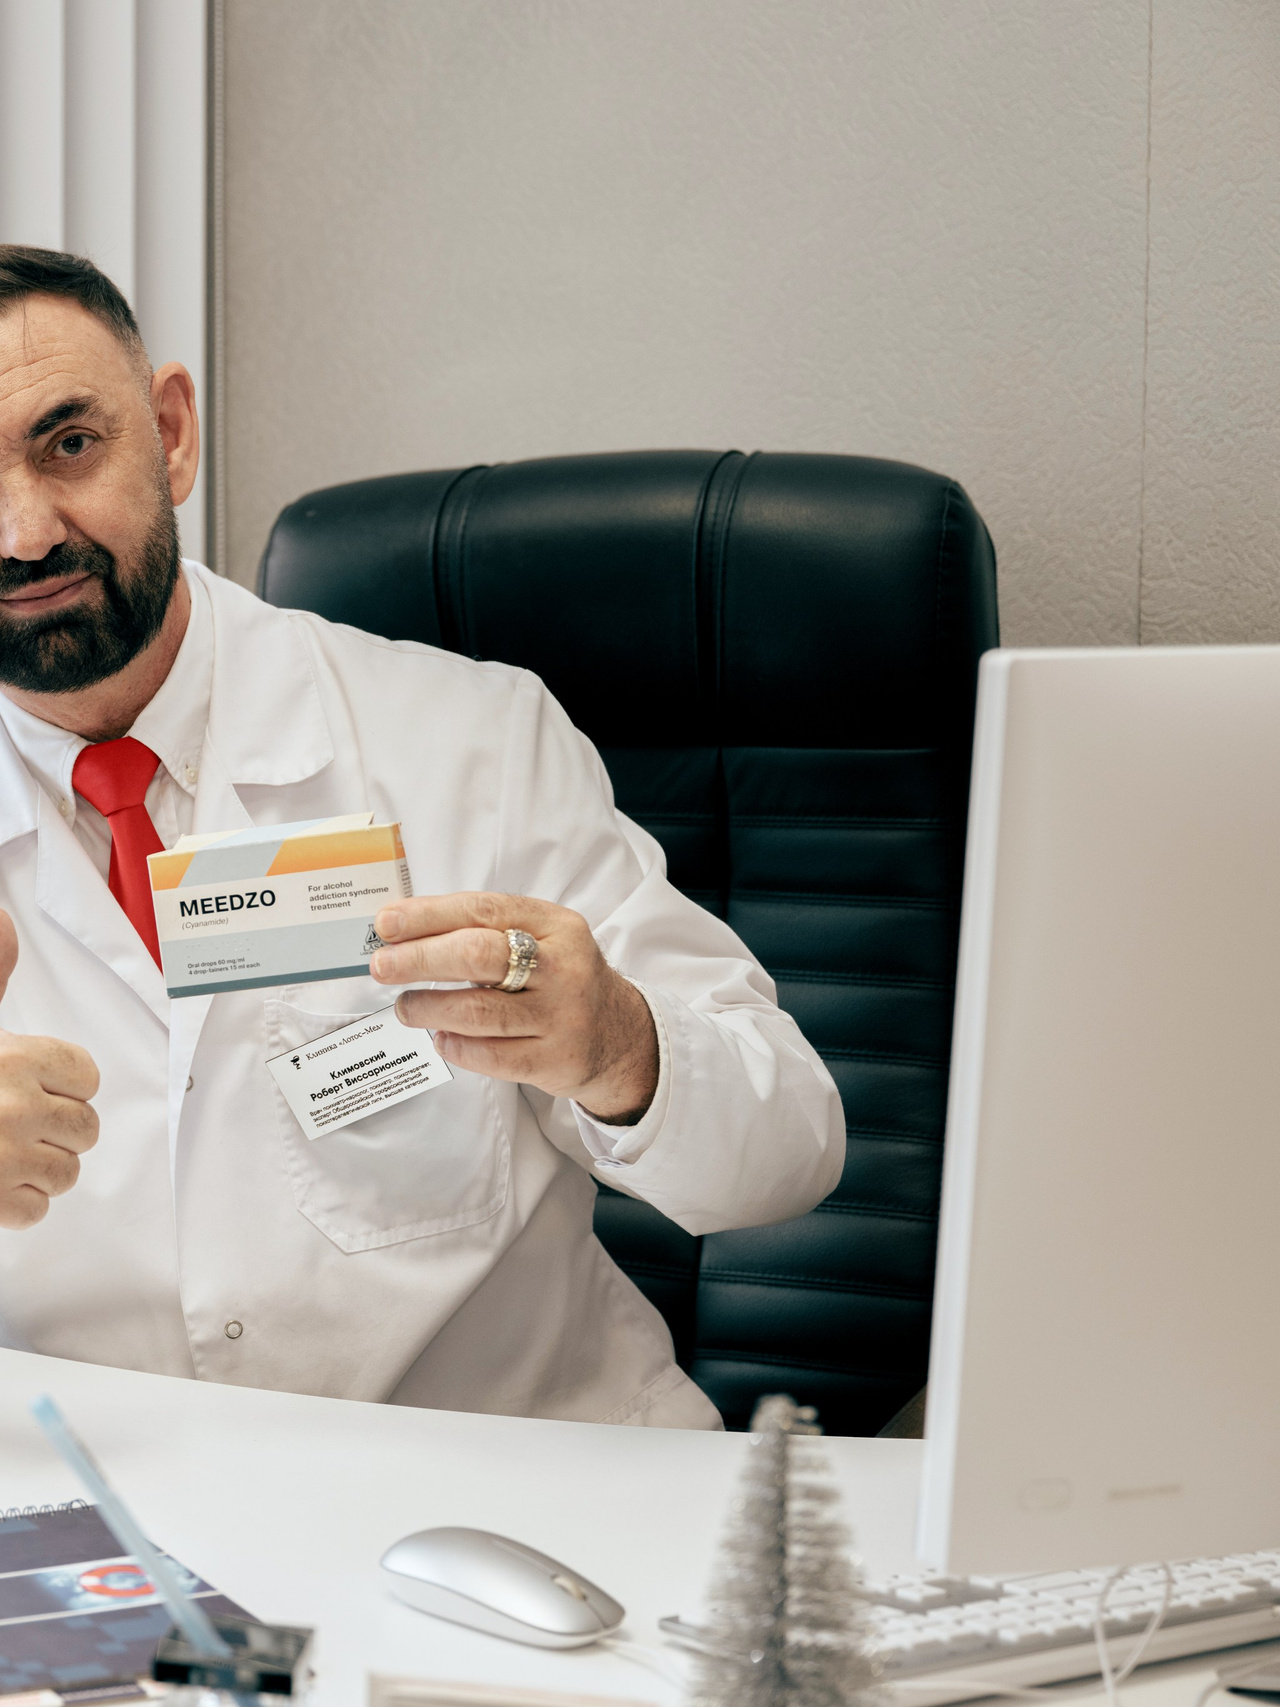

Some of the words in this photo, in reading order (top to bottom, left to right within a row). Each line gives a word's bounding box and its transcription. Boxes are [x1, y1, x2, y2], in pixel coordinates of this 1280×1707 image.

[323, 880, 353, 891] alcohol
[309, 891, 347, 902] addiction
[348, 886, 389, 898] syndrome
[180, 889, 276, 917] MEEDZO
[310, 900, 351, 911] treatment
[181, 917, 229, 930] (Cyanamide)
[193, 966, 229, 975] drop-tainers
[305, 1043, 338, 1061] Клиника
[330, 1050, 387, 1081] Климовский
[310, 1083, 344, 1102] Роберт
[344, 1051, 419, 1087] Виссарионович
